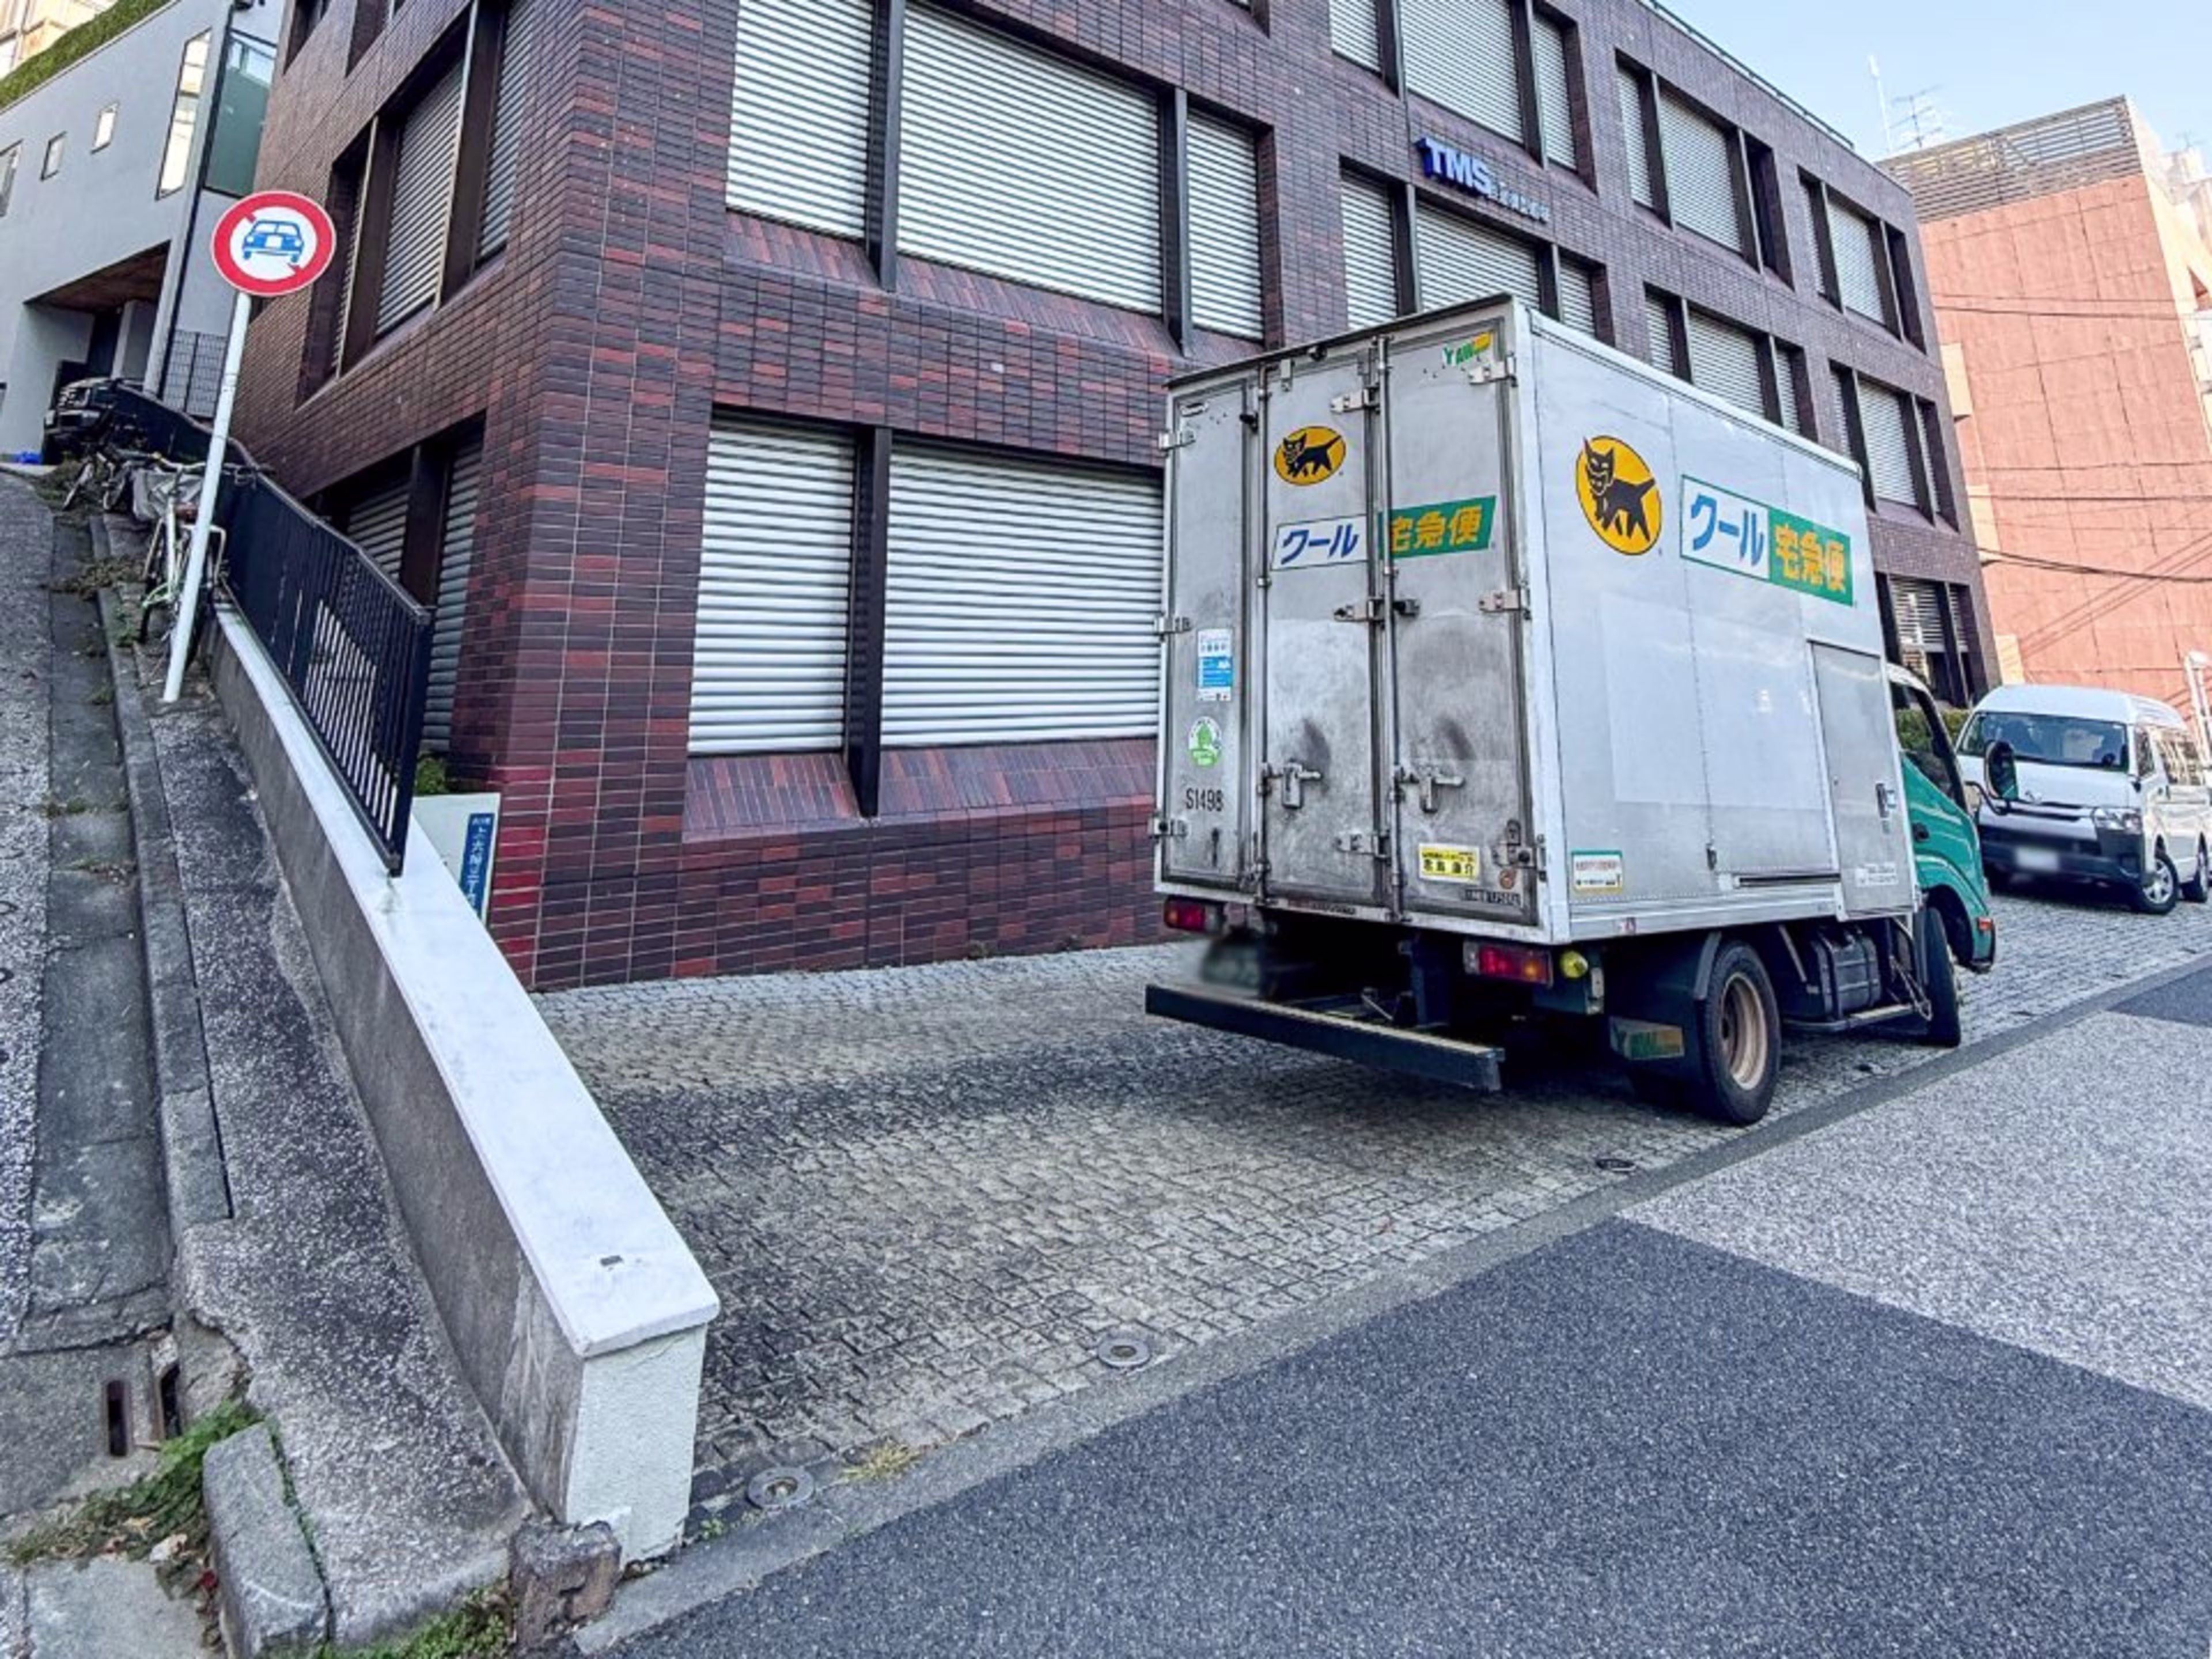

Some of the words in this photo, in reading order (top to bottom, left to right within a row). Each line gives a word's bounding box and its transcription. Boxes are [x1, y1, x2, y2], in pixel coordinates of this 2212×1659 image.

[1421, 138, 1492, 195] TMS
[1281, 524, 1359, 565] クール
[1391, 505, 1482, 552] 宅急便
[1692, 494, 1764, 566] クール
[1775, 524, 1845, 592] 宅急便
[1186, 787, 1224, 812] S1498
